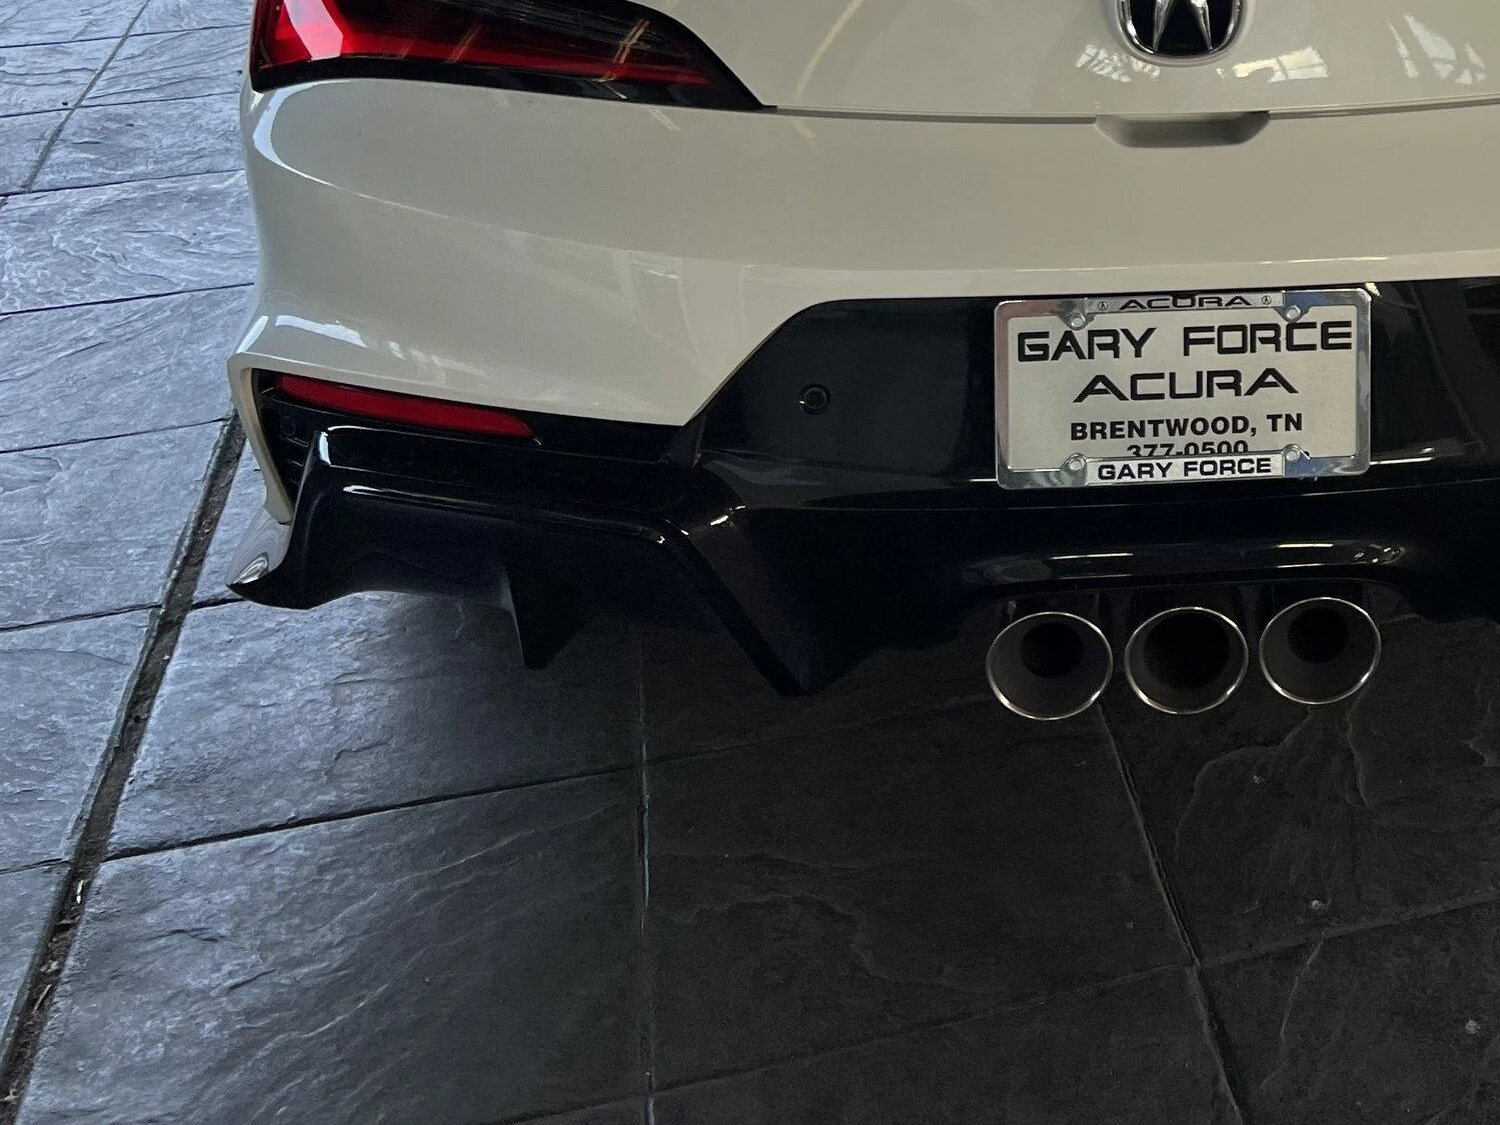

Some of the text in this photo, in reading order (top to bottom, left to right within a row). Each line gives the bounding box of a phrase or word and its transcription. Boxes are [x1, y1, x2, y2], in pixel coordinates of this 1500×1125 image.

[1118, 295, 1253, 310] ACURA
[1017, 320, 1353, 362] GARY FORCE
[1072, 367, 1299, 403] ACURA
[1070, 412, 1303, 441] BRENTWOOD, TN
[1126, 440, 1248, 457] 377-0500
[1098, 457, 1272, 481] GARY FORCE
